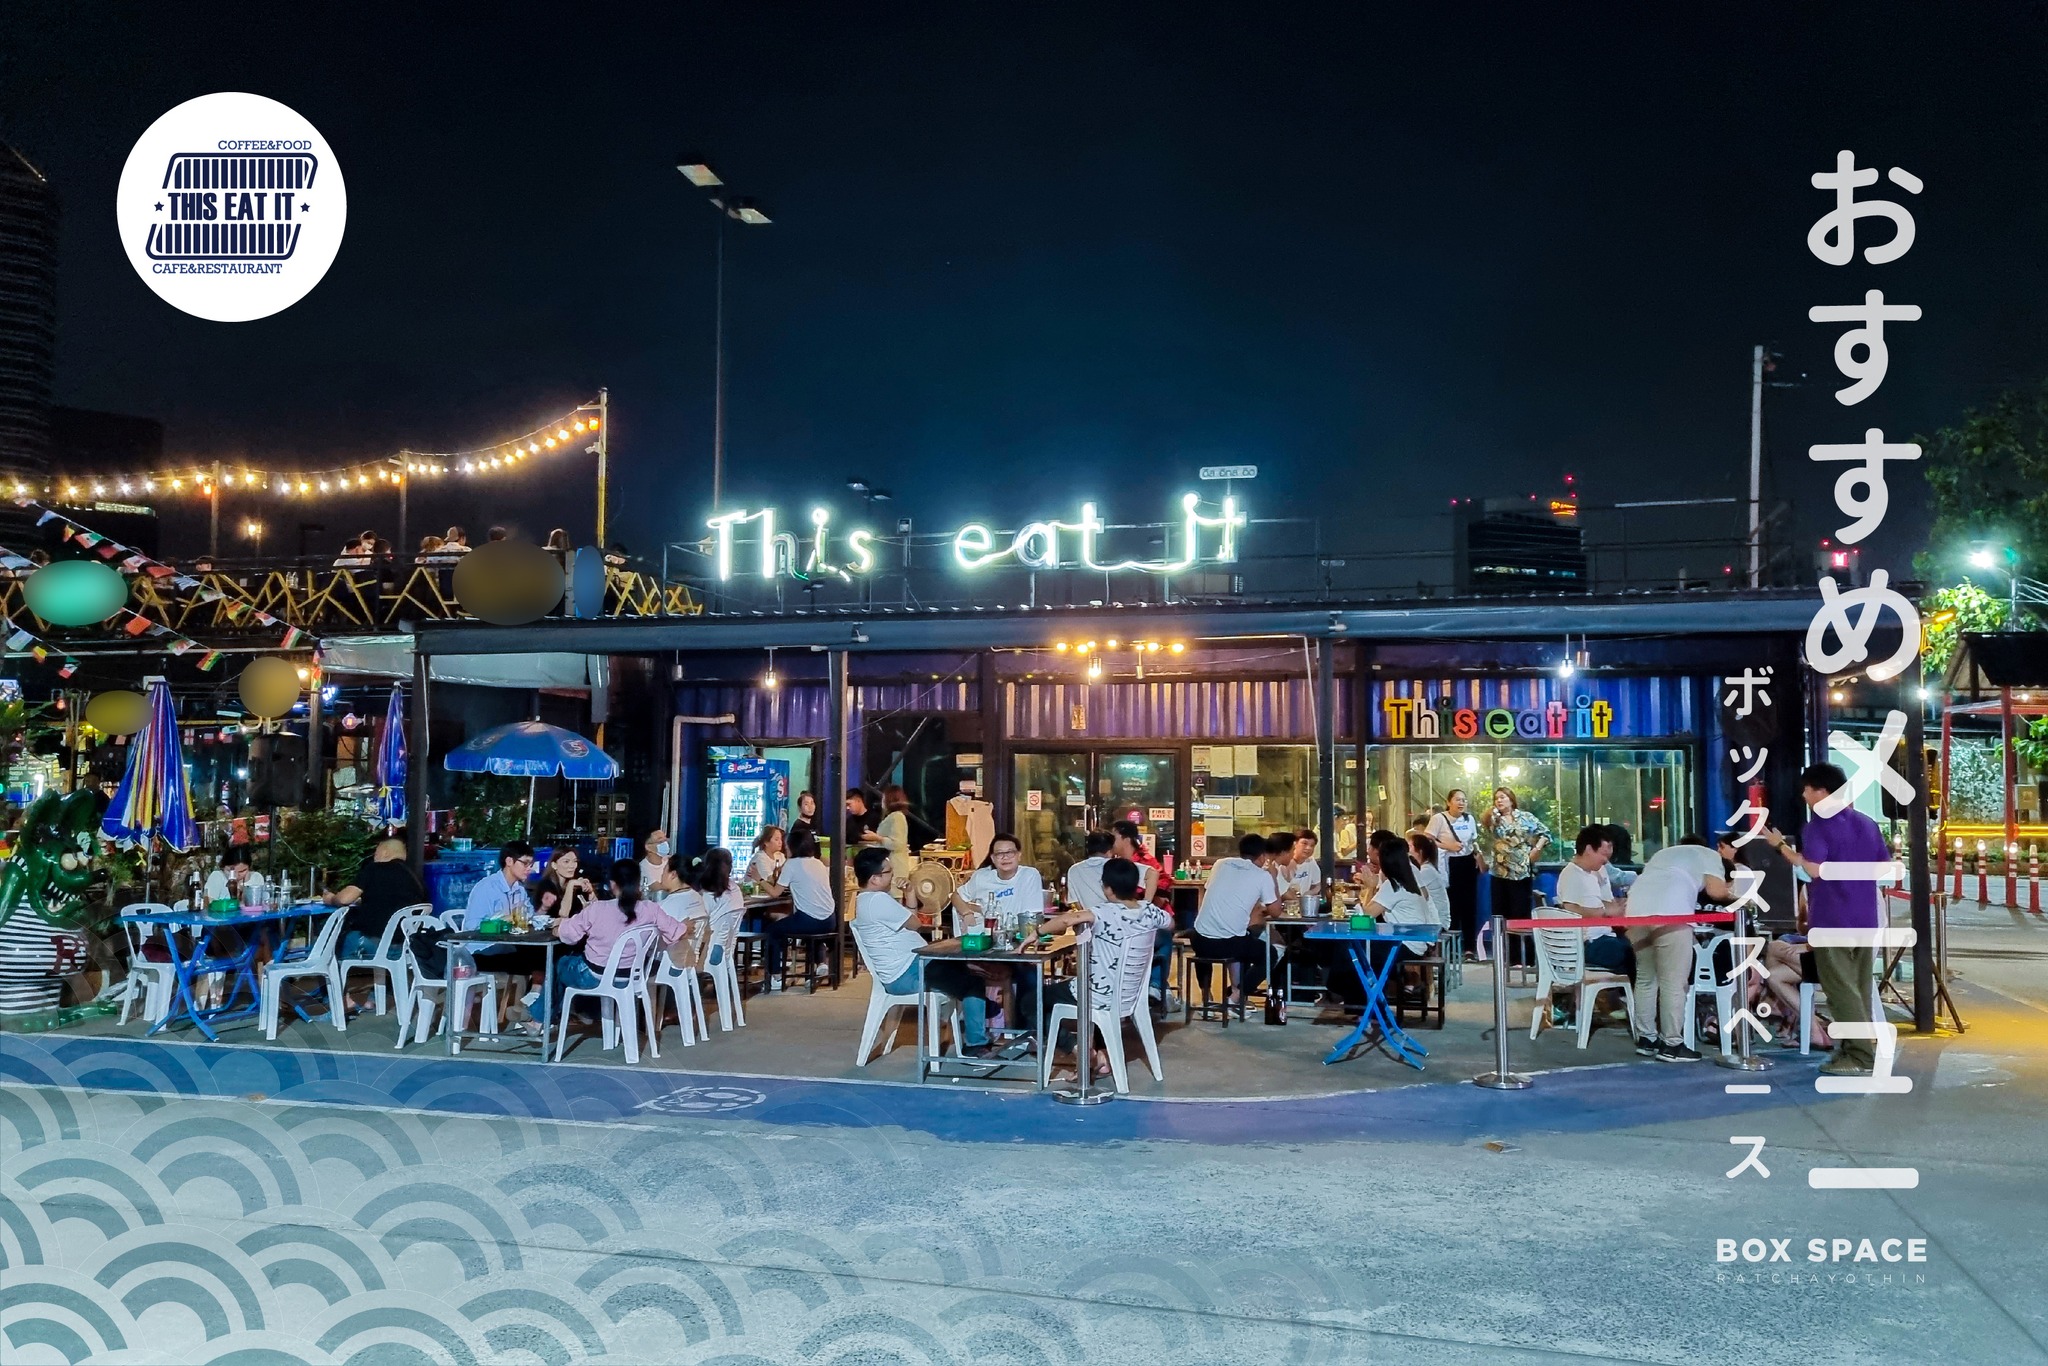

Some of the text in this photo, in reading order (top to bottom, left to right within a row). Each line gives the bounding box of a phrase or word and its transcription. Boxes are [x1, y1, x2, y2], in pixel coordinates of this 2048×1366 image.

[707, 507, 875, 582] This
[952, 501, 1104, 570] eat
[1384, 694, 1612, 739] This eat it
